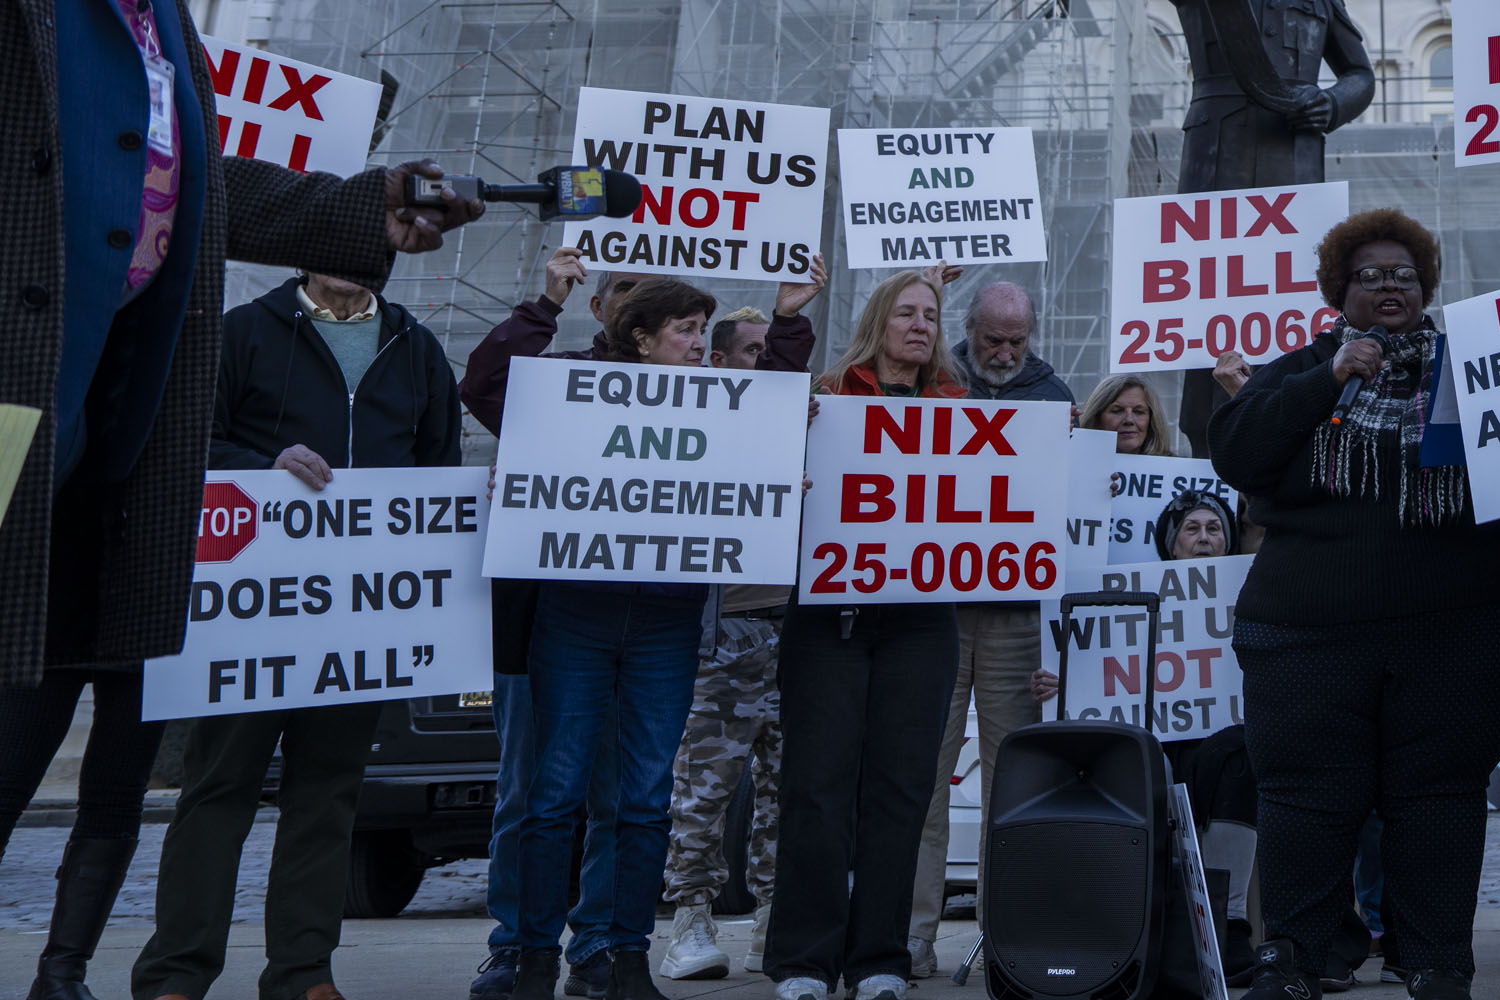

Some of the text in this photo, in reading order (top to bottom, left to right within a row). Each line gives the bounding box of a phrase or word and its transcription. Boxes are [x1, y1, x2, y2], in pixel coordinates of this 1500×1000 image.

[201, 43, 333, 121] NIX
[644, 101, 765, 143] PLAN
[584, 139, 816, 187] WITH US
[876, 133, 995, 157] EQUITY
[908, 167, 974, 189] AND
[632, 185, 760, 231] NOT
[851, 199, 1033, 225] ENGAGEMENT
[1161, 192, 1299, 244] NIX
[576, 230, 809, 274] AGAINST US
[881, 234, 1013, 261] MATTER
[1143, 251, 1318, 303] BILL
[566, 368, 753, 411] EQUITY
[601, 424, 708, 461] AND
[864, 405, 1018, 456] NIX
[501, 473, 791, 517] ENGAGEMENT
[840, 473, 1034, 523] BILL
[1171, 476, 1230, 501] SIZE
[198, 507, 251, 537] TOP
[387, 496, 477, 535] SIZE
[538, 531, 743, 573] MATTER
[810, 541, 1056, 594] 25-0066
[190, 569, 452, 622] DOES NOT
[1049, 606, 1234, 652] WITH U
[208, 655, 296, 703] FIT
[1103, 648, 1222, 697] NOT
